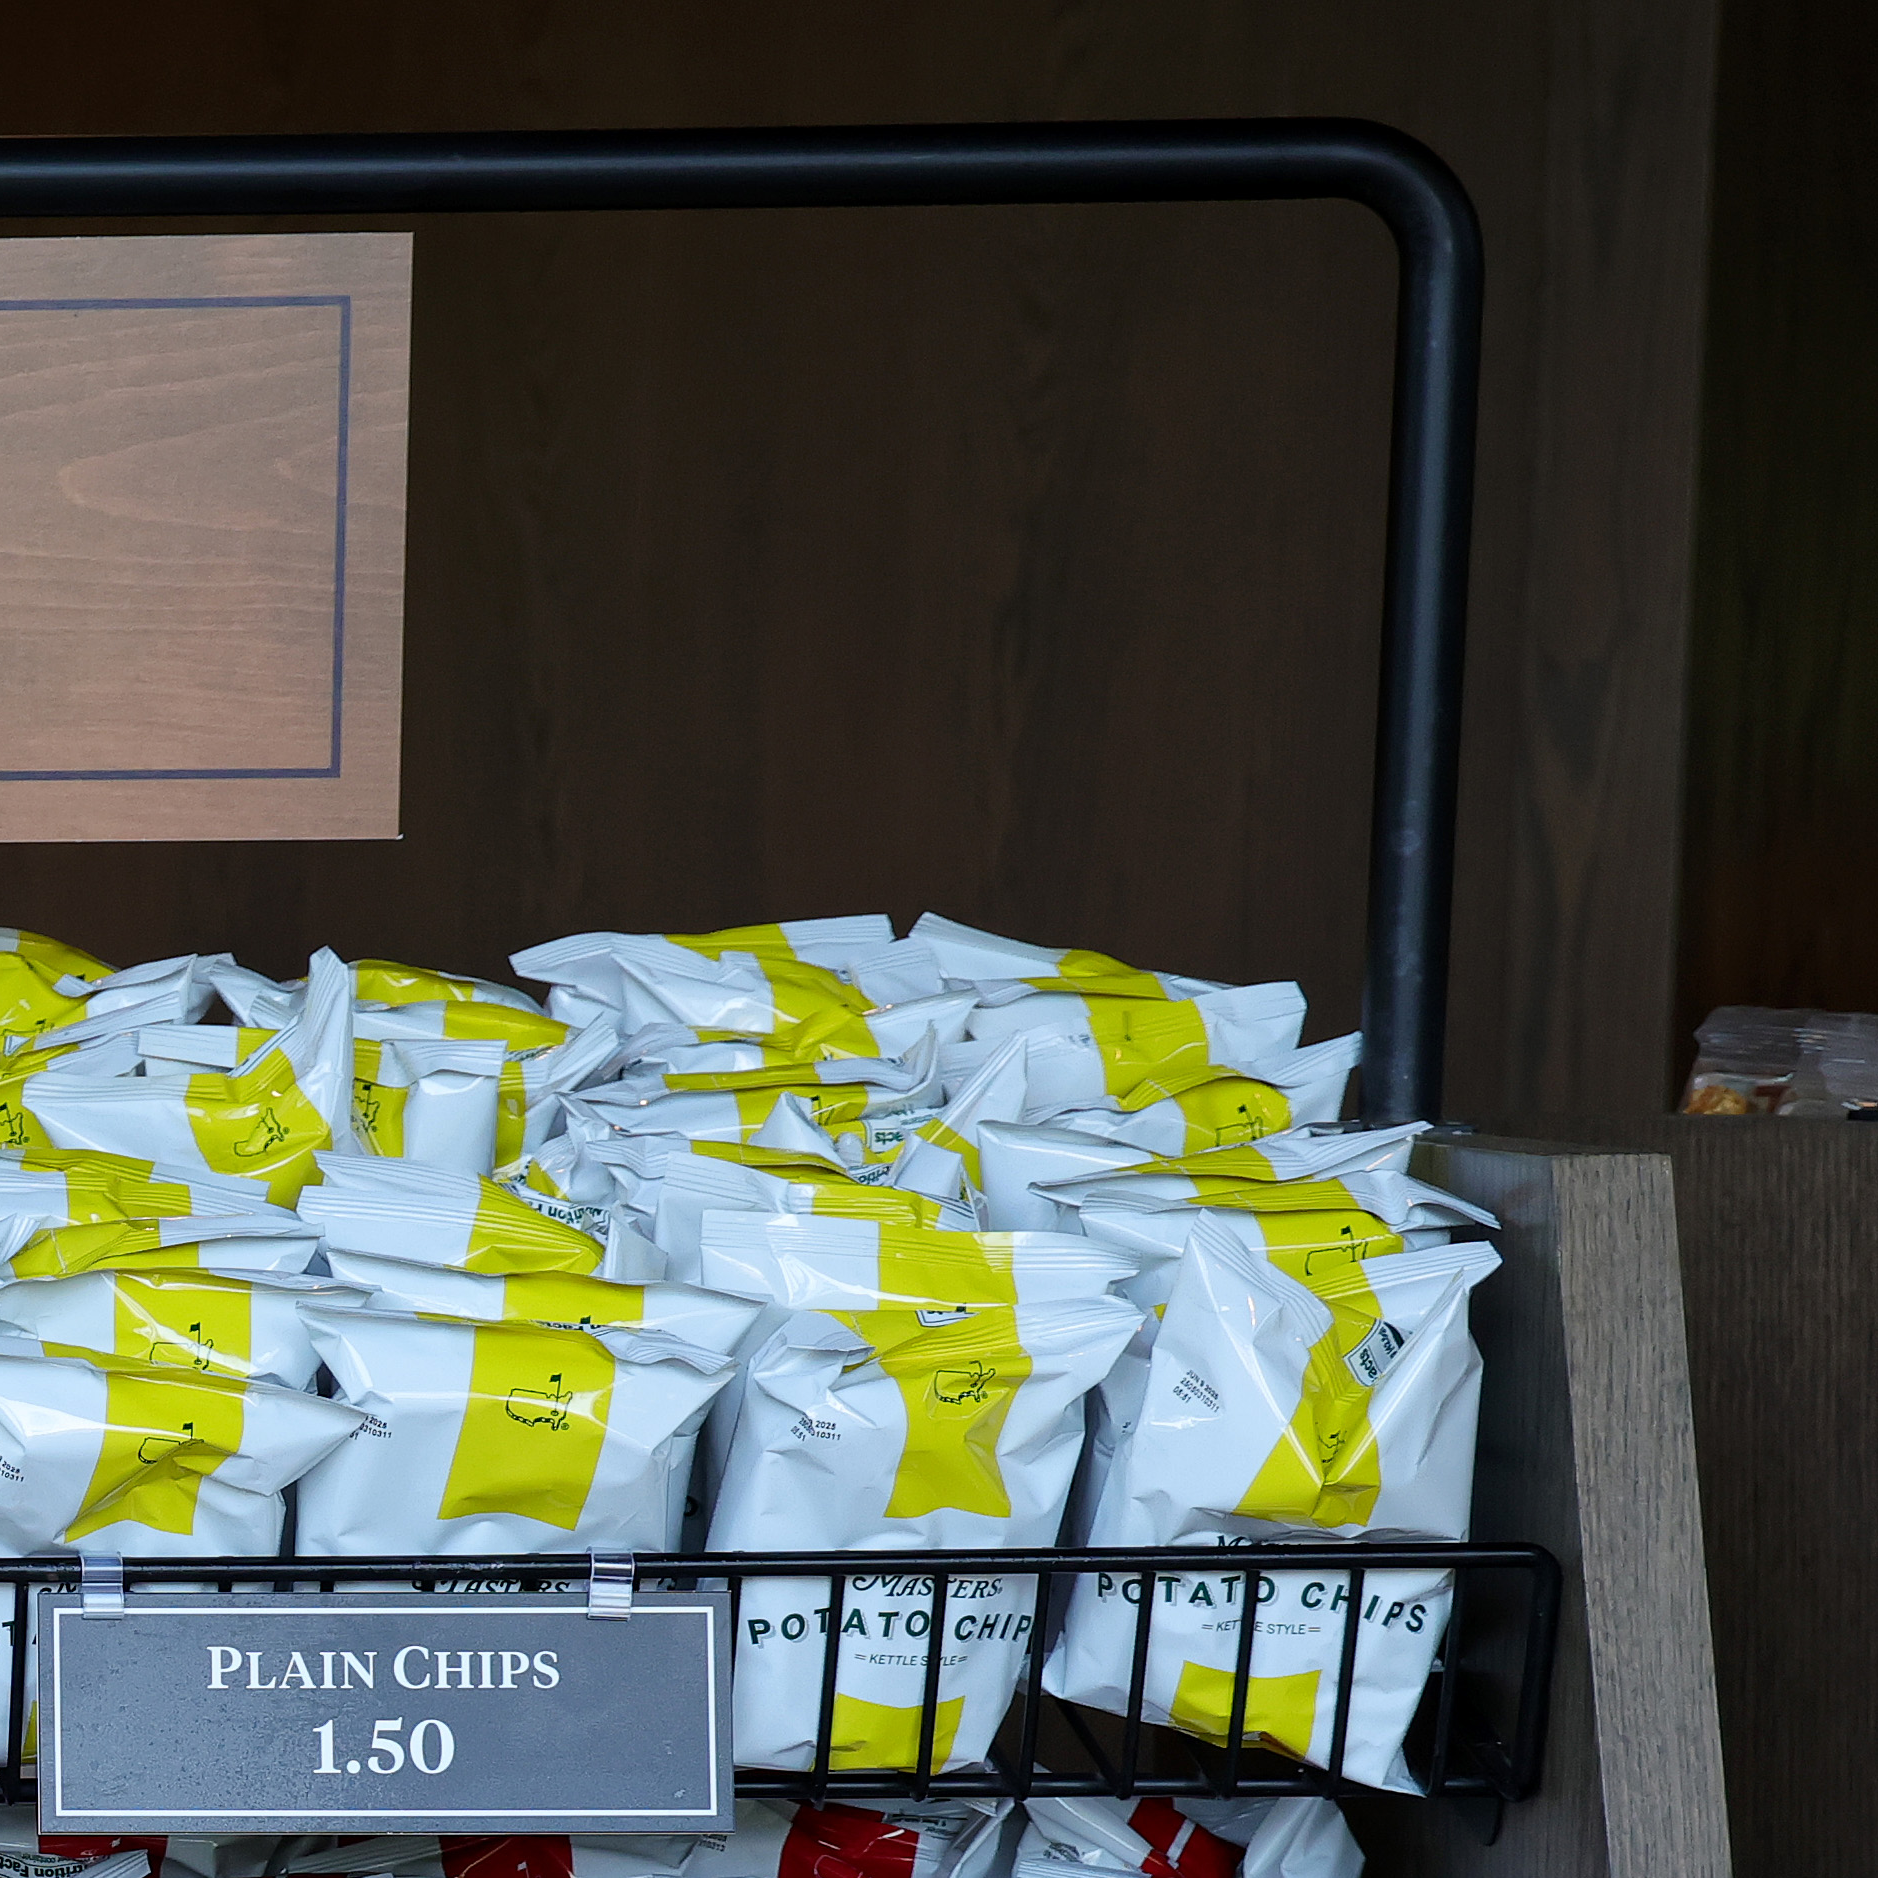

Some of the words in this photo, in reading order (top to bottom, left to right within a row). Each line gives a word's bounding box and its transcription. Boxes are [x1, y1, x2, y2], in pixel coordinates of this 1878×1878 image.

[1097, 1572, 1276, 1607] POTATO
[1301, 1581, 1428, 1633] CHIPS
[747, 1608, 930, 1645] POTATO
[955, 1614, 1032, 1642] CHIP
[1216, 1620, 1262, 1632] KETE
[1267, 1622, 1306, 1636] STYLE
[202, 1641, 377, 1695] PLAIN
[394, 1646, 559, 1689] CHIPS
[869, 1654, 917, 1666] KETTLE
[306, 1713, 454, 1780] 1.50
